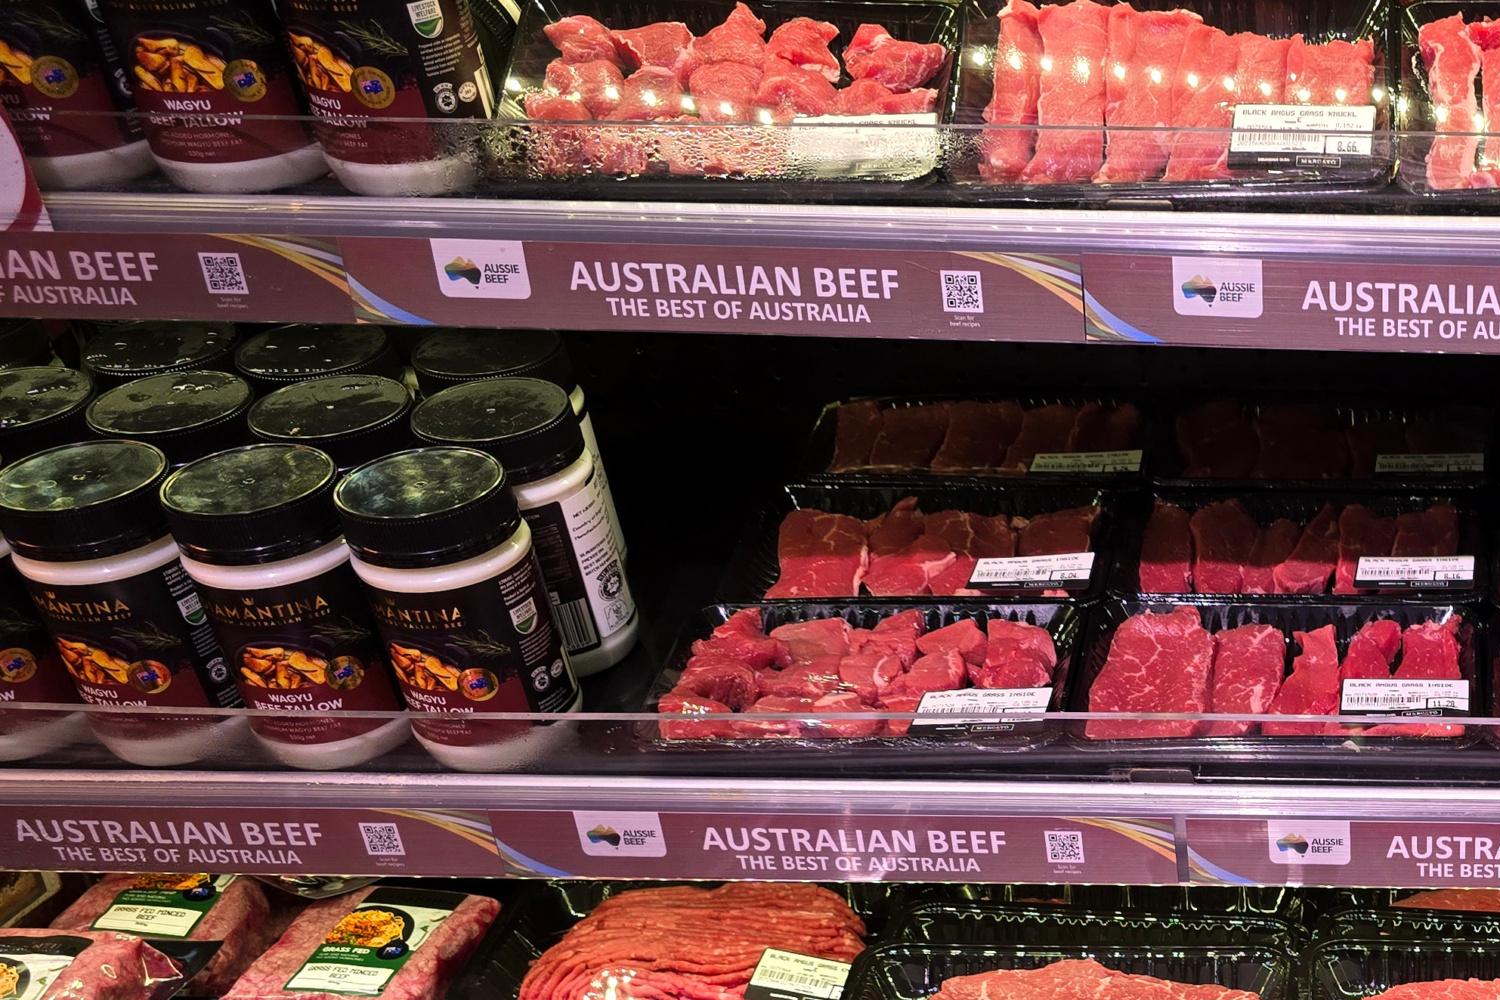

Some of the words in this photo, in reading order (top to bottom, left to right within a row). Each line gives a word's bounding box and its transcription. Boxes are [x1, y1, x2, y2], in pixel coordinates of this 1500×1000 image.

[163, 99, 211, 111] WAGYU
[74, 251, 158, 281] BEEF
[484, 264, 519, 275] AUSSIE
[484, 273, 509, 284] BEEF
[570, 261, 802, 297] AUSTRALIAN
[816, 267, 898, 299] BEEF
[1220, 282, 1255, 294] AUSSIE
[13, 286, 136, 305] AUSTRALIA
[1220, 292, 1244, 303] BEEF
[606, 298, 650, 317] THE
[656, 299, 707, 318] BEST
[713, 300, 743, 320] OF
[749, 300, 870, 323] AUSTRALIA
[1335, 317, 1378, 337] THE
[1384, 317, 1433, 338] BEST
[1439, 318, 1468, 340] OF
[268, 693, 313, 702] WAGYU
[17, 819, 231, 846] AUSTRALIAN
[240, 822, 322, 846] BEEF
[623, 829, 657, 839] AUSSIE
[624, 837, 645, 845] BEEF
[703, 827, 918, 853] AUSTRALIAN
[929, 831, 1007, 855] BEEF
[1311, 838, 1343, 847] AUSSIE
[53, 846, 95, 861] THE
[100, 847, 146, 862] BEST
[151, 848, 181, 863] OF
[187, 849, 302, 865] AUSTRALIA
[1311, 845, 1333, 854] BEEF
[736, 855, 777, 870] THE
[782, 856, 830, 871] BEST
[836, 856, 863, 872] OF
[869, 857, 981, 873] AUSTRALIA
[1417, 863, 1455, 877] THE
